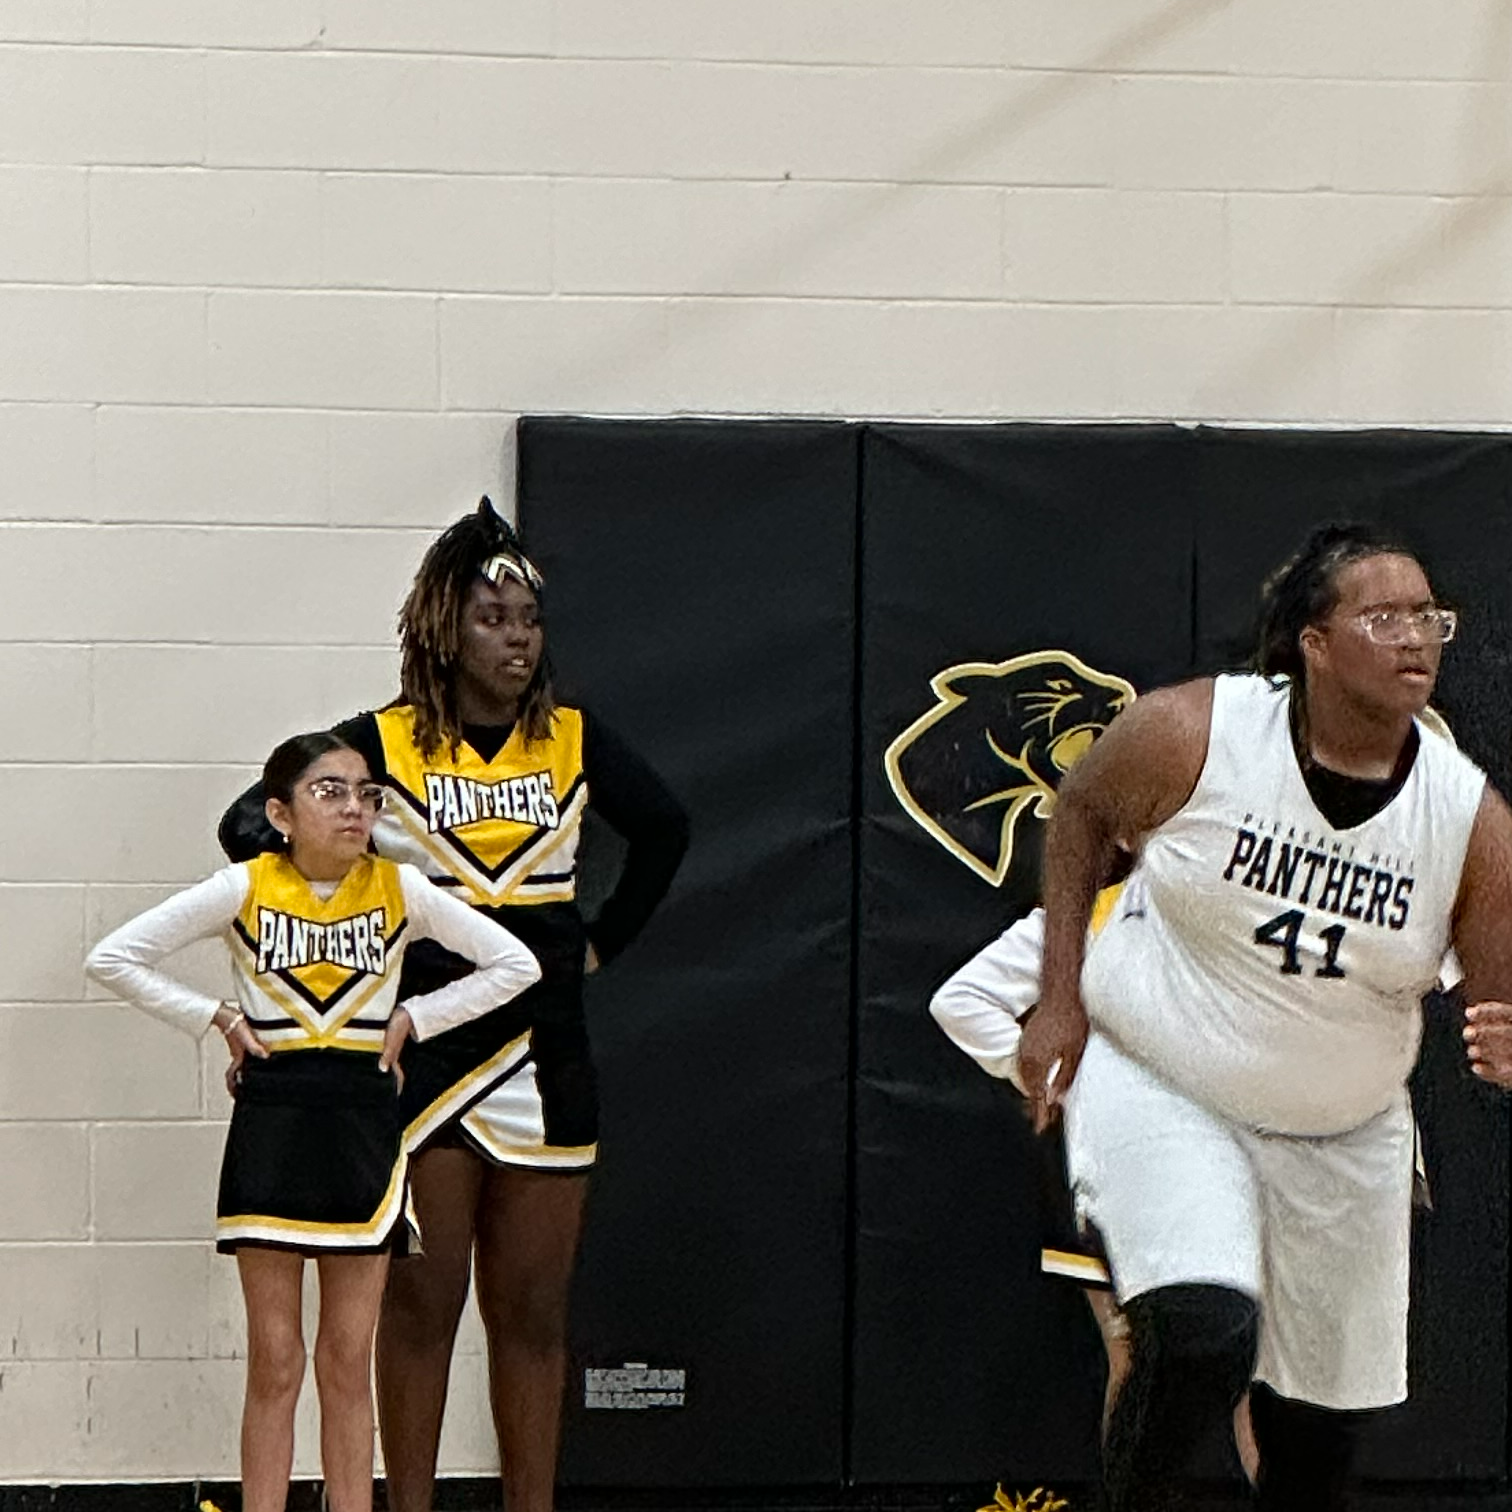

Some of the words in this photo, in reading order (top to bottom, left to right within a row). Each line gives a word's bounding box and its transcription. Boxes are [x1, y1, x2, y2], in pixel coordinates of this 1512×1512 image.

[423, 769, 560, 834] PANTHERS
[1222, 828, 1415, 931] PANTHERS
[255, 905, 386, 976] PANTHERS
[1254, 909, 1347, 978] 41
